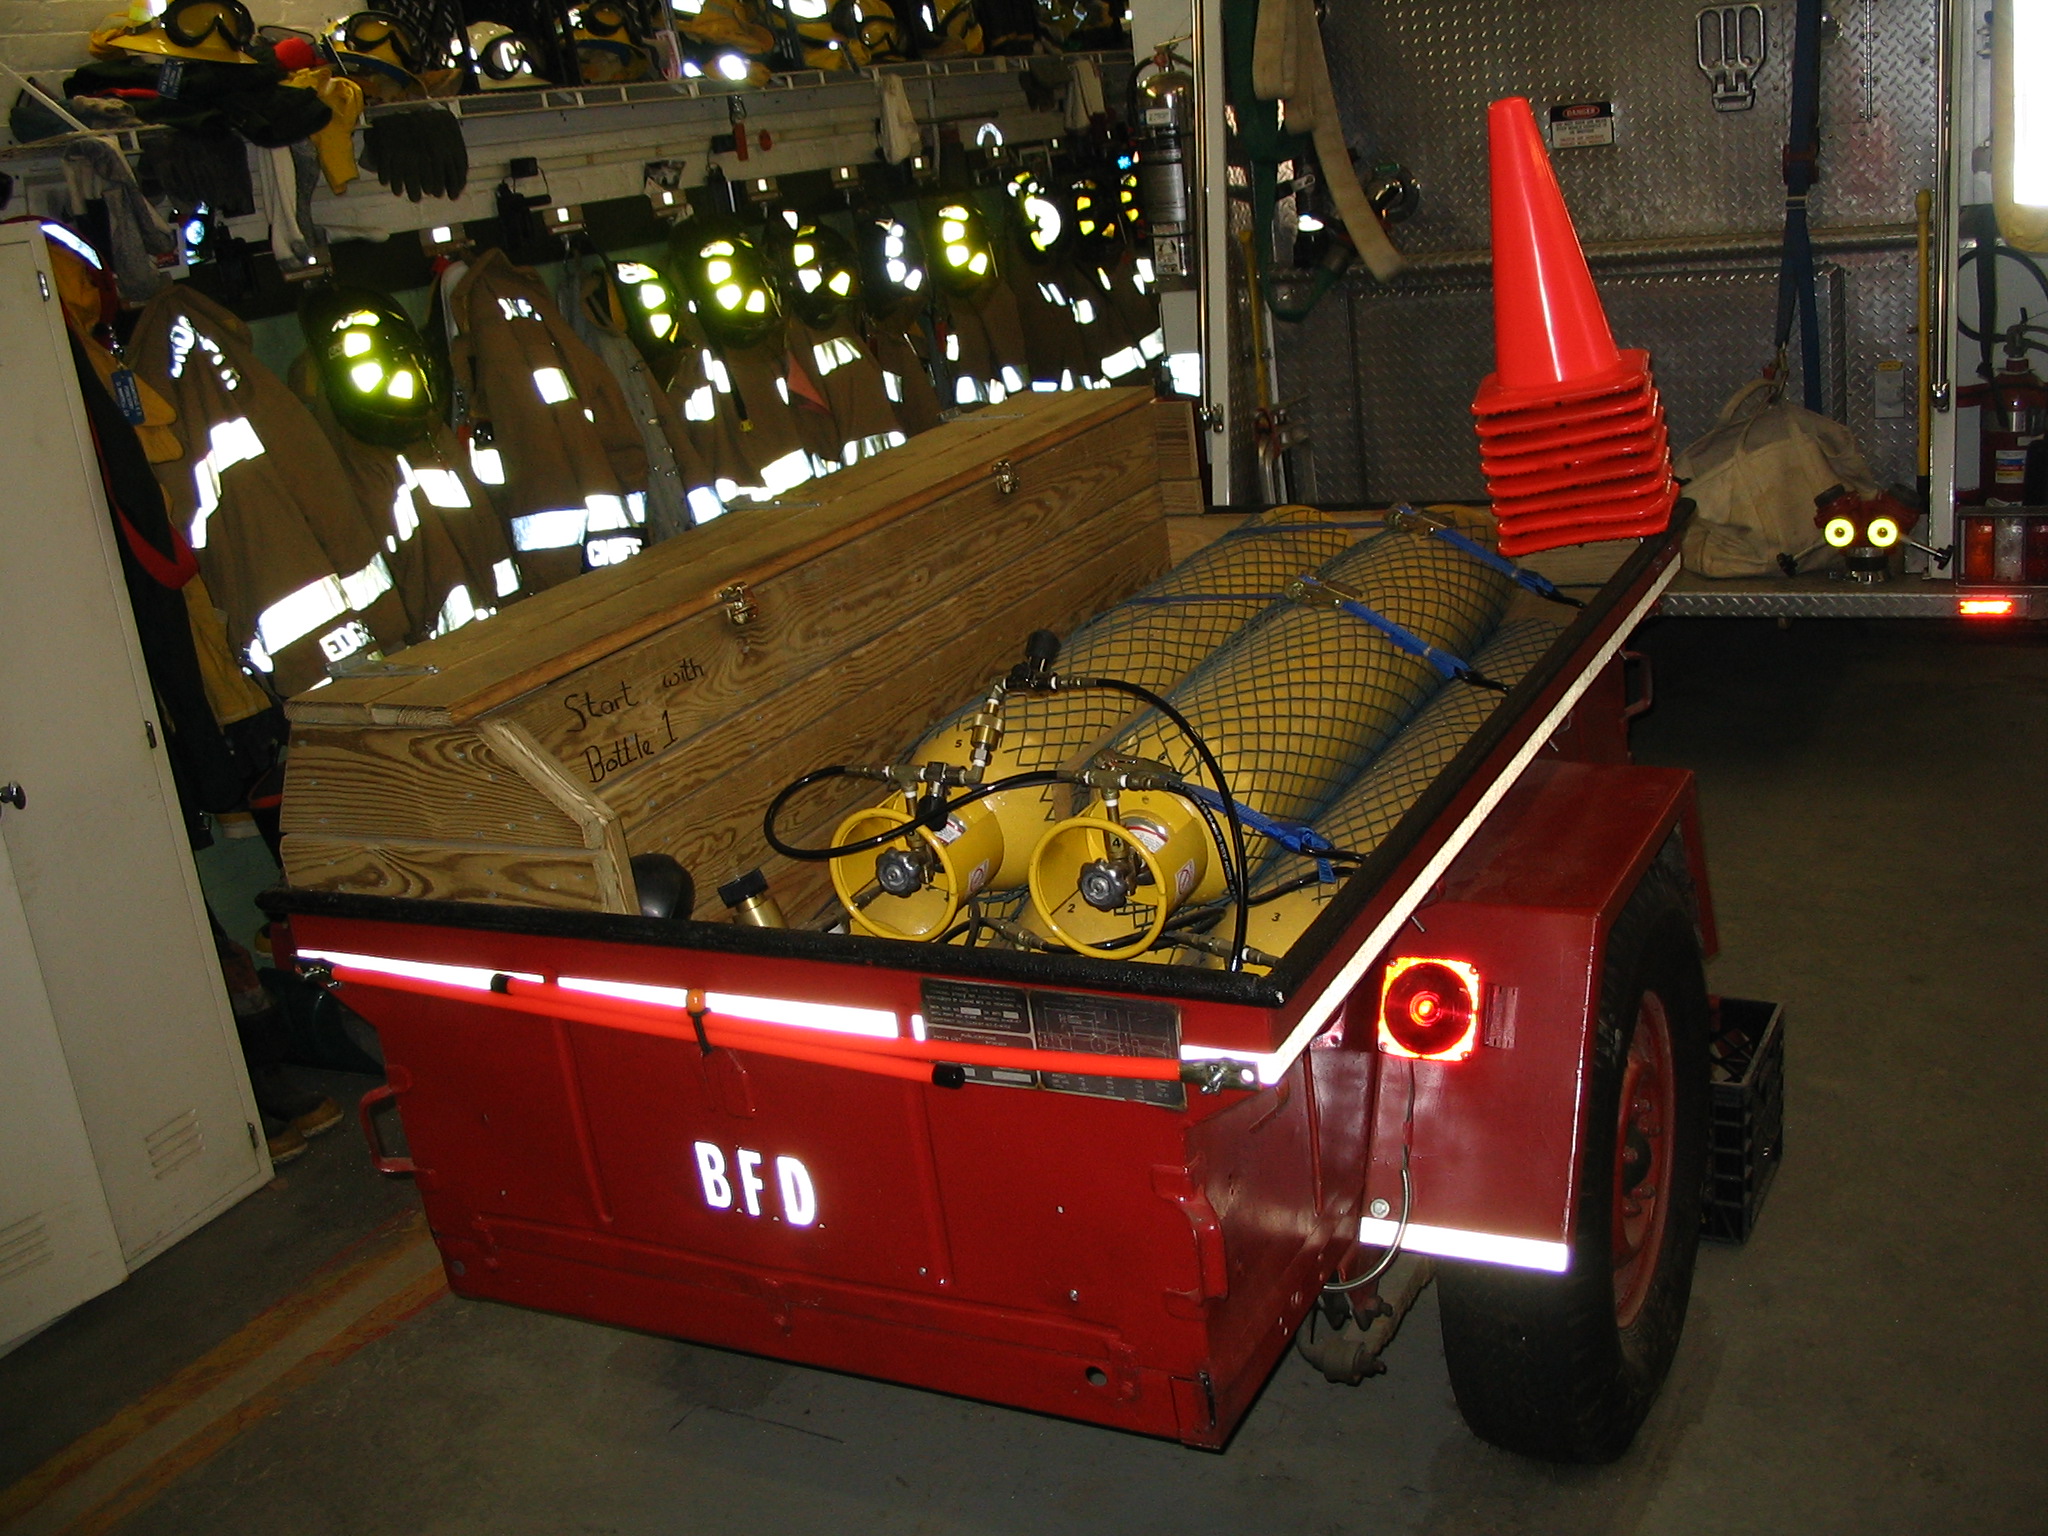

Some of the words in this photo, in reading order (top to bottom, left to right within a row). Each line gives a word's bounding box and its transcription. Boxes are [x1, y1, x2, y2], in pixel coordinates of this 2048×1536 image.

[564, 681, 639, 732] Start
[663, 658, 704, 688] with
[580, 733, 654, 783] Bottle
[662, 710, 679, 749] 1
[1112, 837, 1121, 848] 4
[1067, 903, 1075, 913] 2
[1271, 912, 1281, 922] 3
